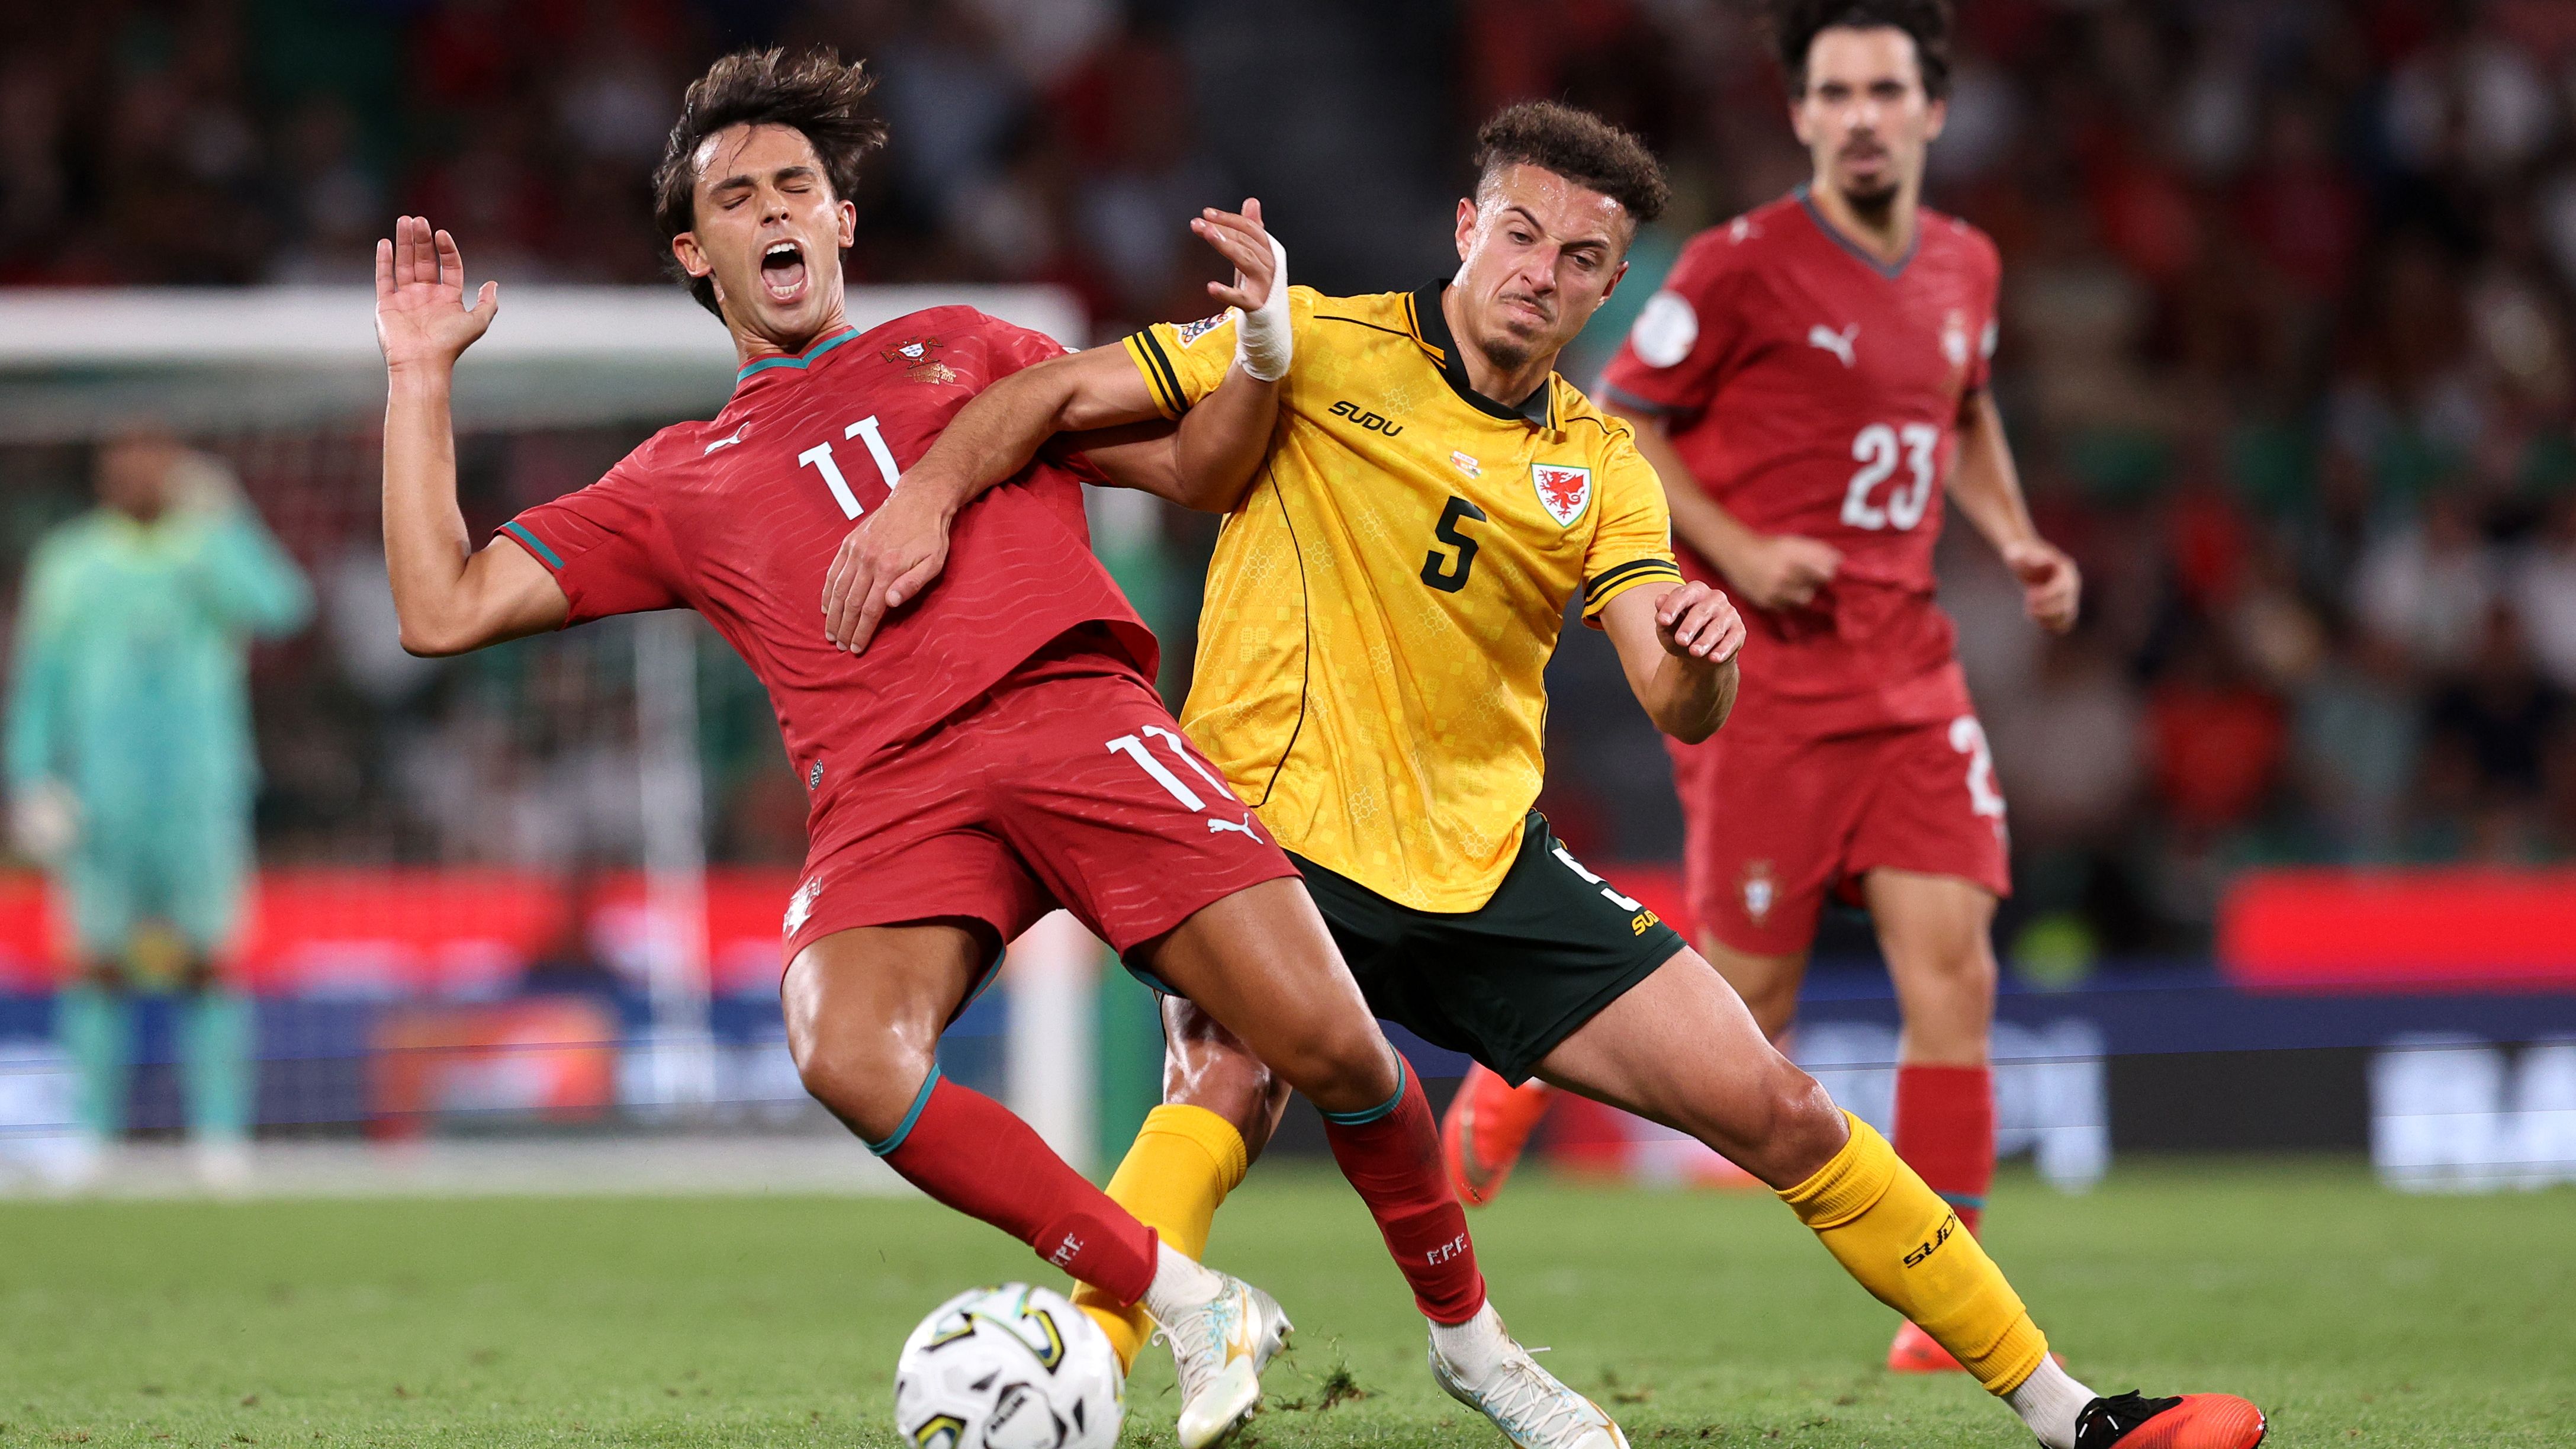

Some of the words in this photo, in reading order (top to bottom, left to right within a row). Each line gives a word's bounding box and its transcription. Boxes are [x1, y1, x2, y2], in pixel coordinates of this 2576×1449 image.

[1328, 401, 1403, 436] SUDU
[797, 415, 901, 521] 11
[1841, 422, 1940, 531] 23
[1420, 495, 1487, 593] 5
[1105, 725, 1236, 812] 11
[1427, 1232, 1467, 1266] F.P.F.
